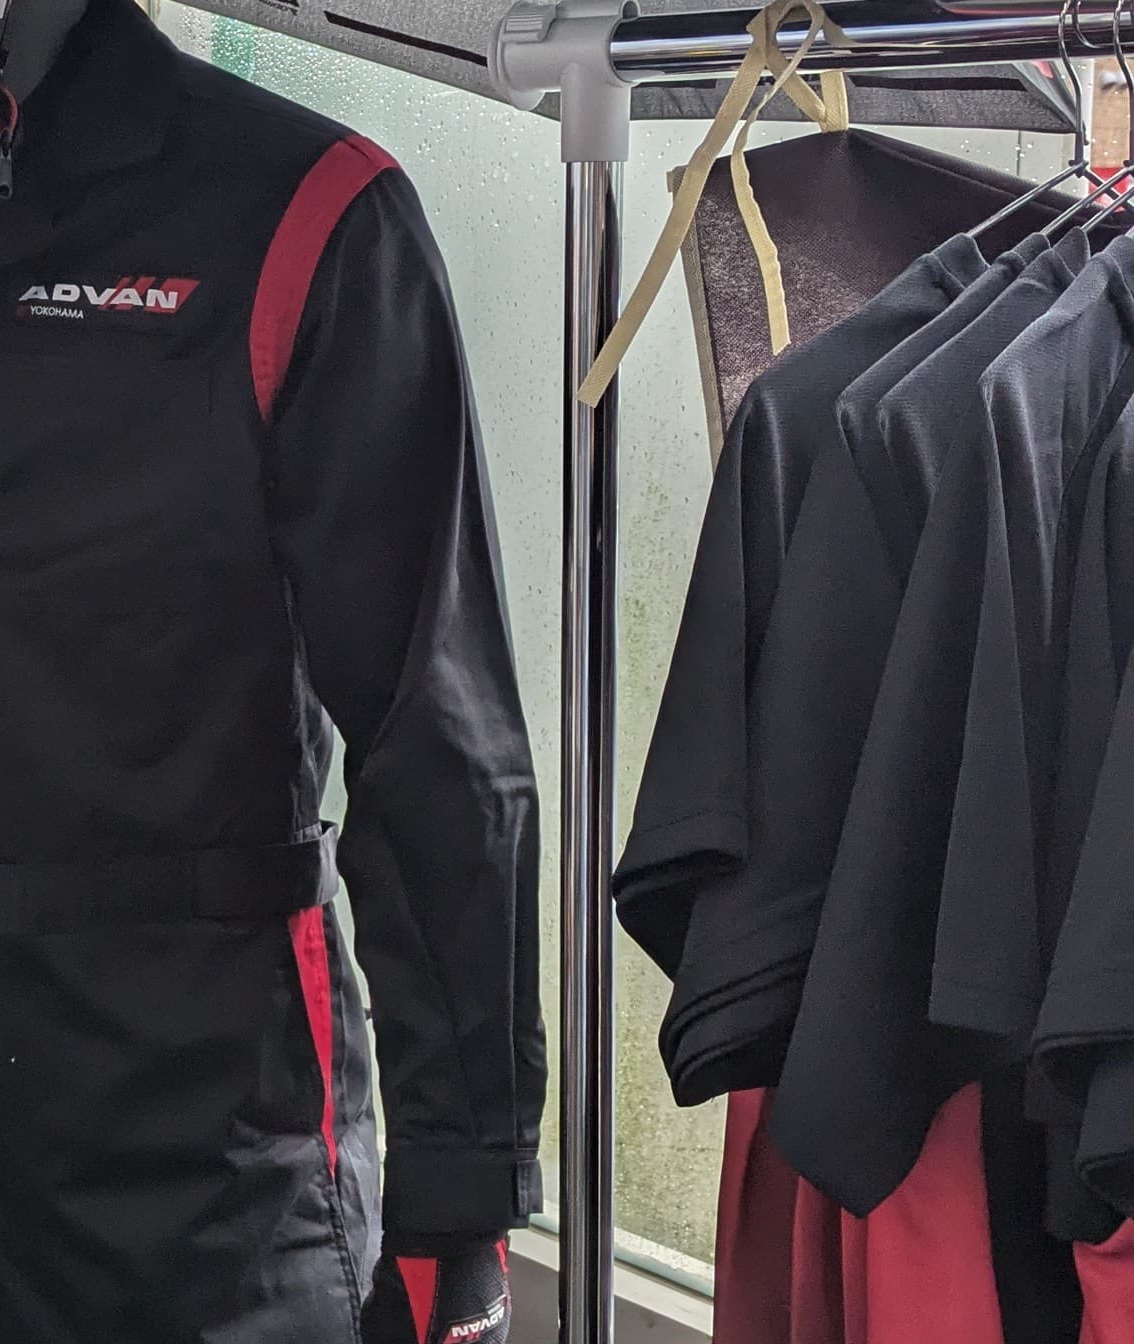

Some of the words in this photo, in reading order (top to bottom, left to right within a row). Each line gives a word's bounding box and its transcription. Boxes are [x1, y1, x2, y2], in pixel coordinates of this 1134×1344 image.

[18, 283, 179, 309] ADVAN
[30, 305, 84, 319] YOKOHAMA
[451, 1306, 506, 1338] ADVAN
